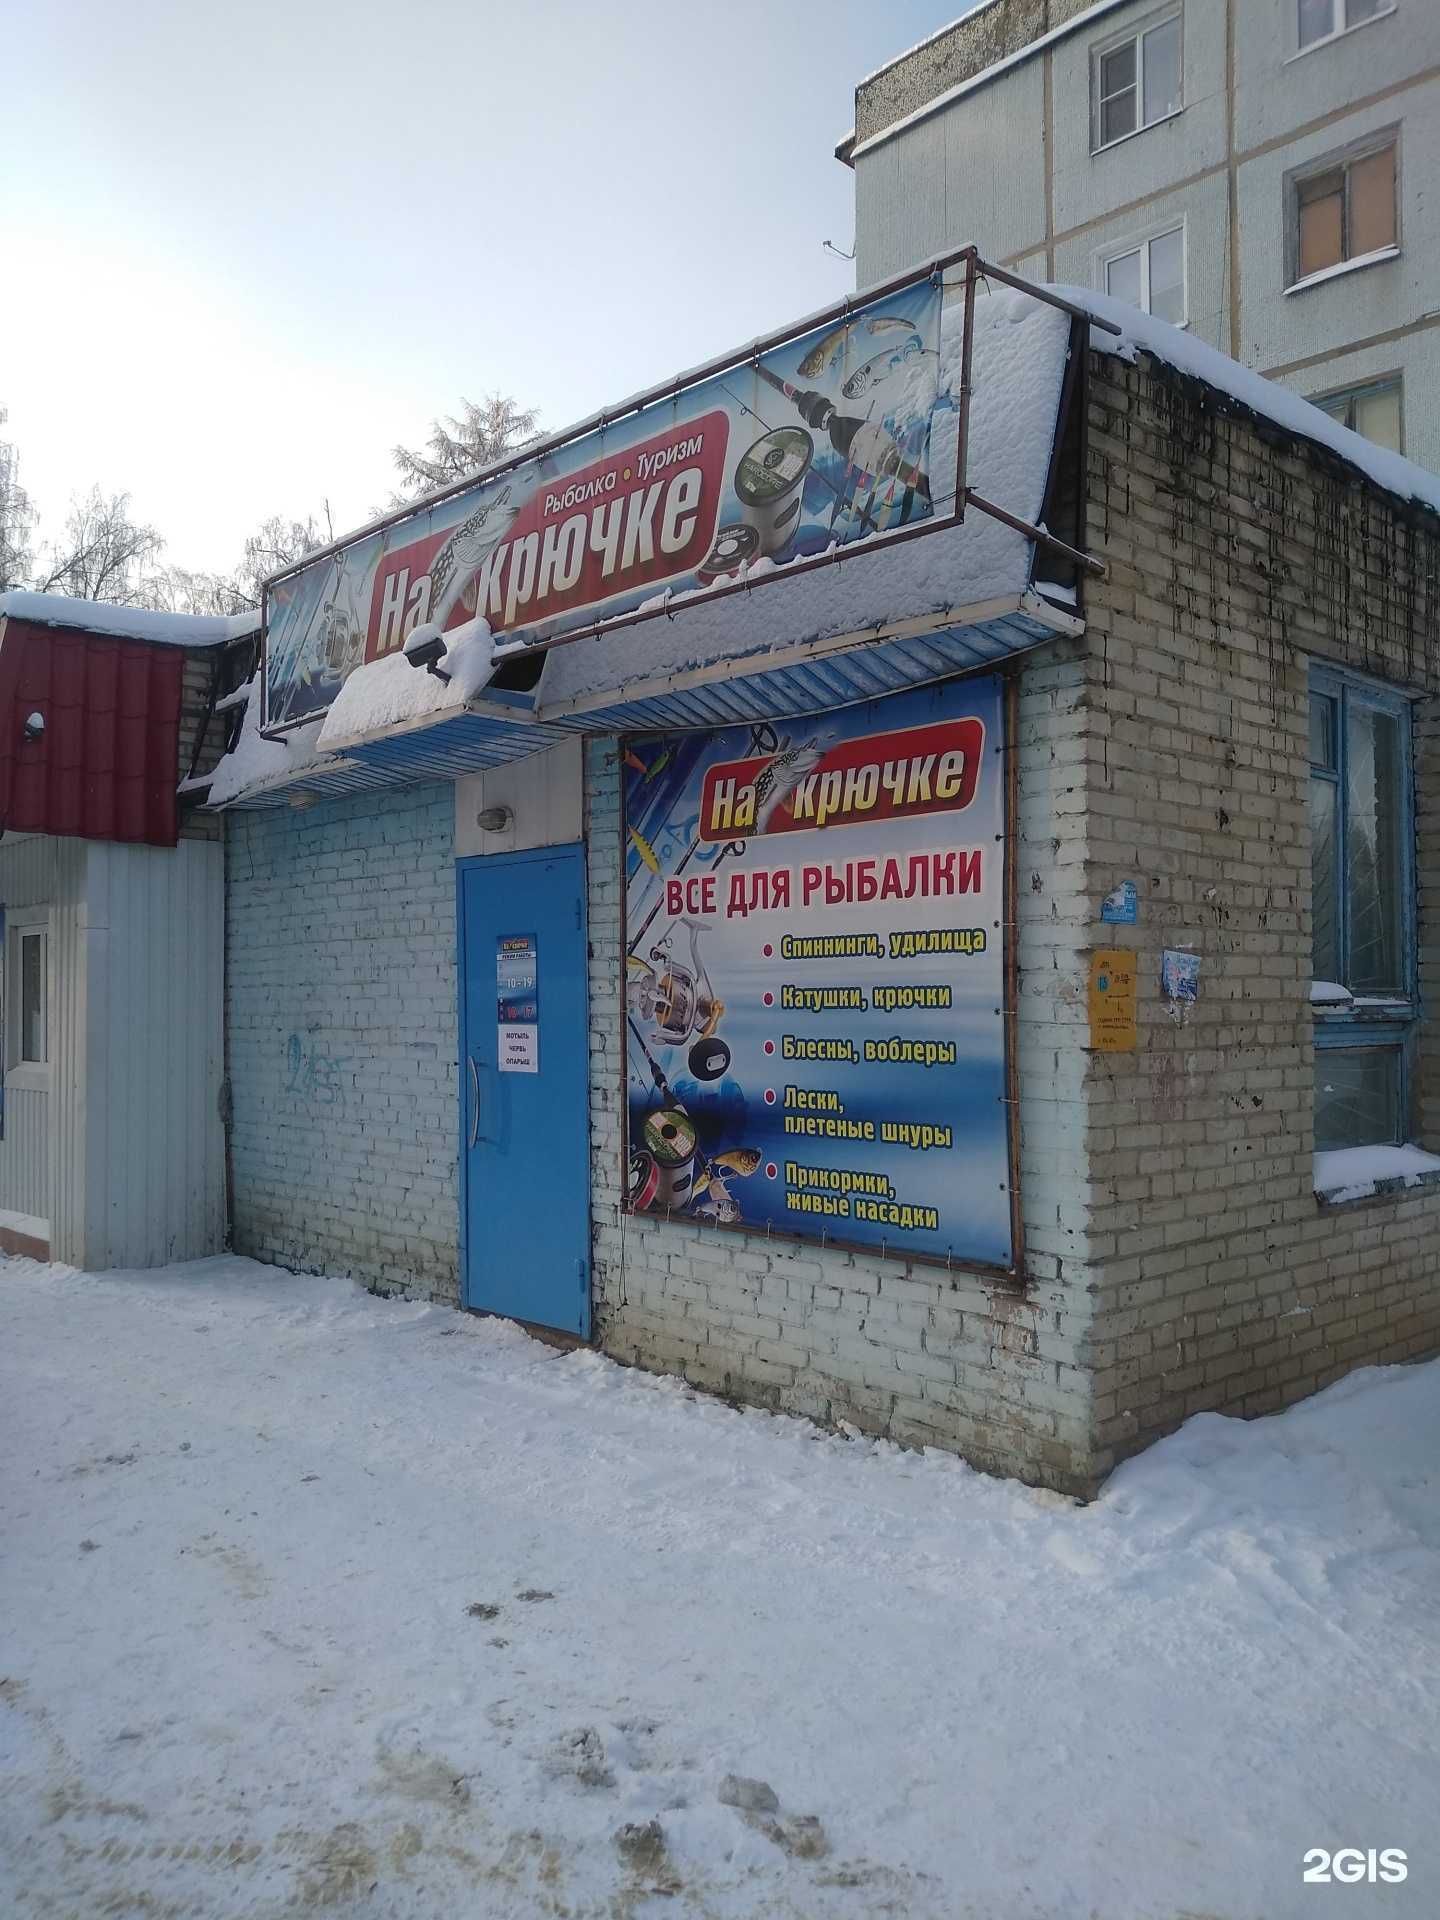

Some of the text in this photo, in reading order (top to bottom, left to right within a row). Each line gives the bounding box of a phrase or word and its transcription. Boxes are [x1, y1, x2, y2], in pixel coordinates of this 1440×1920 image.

[543, 470, 617, 517] Рыбалка
[637, 434, 704, 481] Туризм
[376, 467, 703, 653] На крючке
[710, 749, 966, 831] На крючке
[666, 849, 983, 919] ВСЕ ДЛЯ РЫБАЛКИ
[782, 928, 986, 959] Спиннинги, удилища
[782, 985, 952, 1012] Катушки, крючки
[782, 1035, 956, 1066] Блесны, воблеры
[784, 1085, 844, 1114] Лески,
[784, 1115, 952, 1149] плетеные шнуры
[784, 1161, 896, 1199] Прикормки,
[785, 1190, 938, 1230] живые насадки
